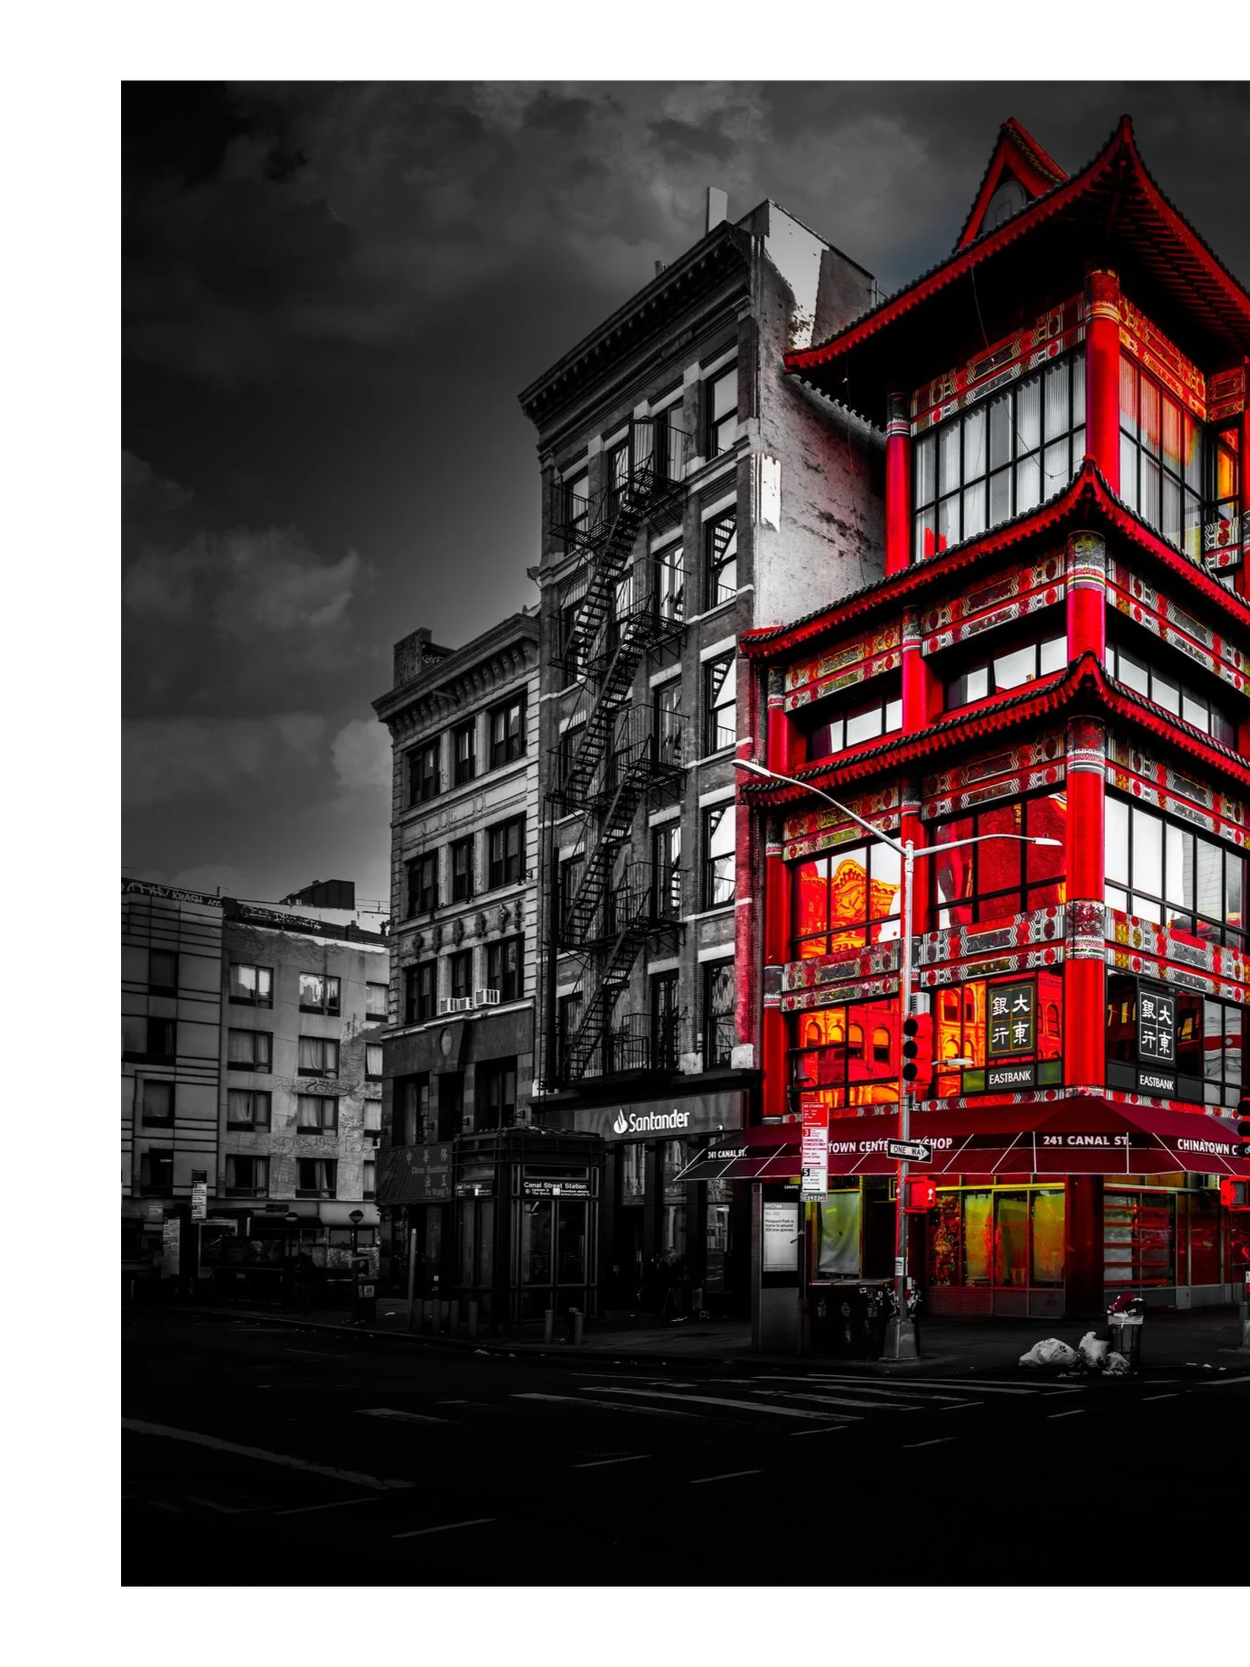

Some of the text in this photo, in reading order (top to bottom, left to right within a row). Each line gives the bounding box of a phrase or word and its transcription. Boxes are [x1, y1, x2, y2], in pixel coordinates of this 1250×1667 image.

[989, 1069, 1031, 1085] EASTBANK
[1139, 1074, 1174, 1091] EASTBANK
[628, 1108, 690, 1132] Santander
[859, 1140, 888, 1153] CENTE
[1043, 1135, 1132, 1146] 241 CANAL ST.
[1177, 1138, 1231, 1156] CHINATOWN
[707, 1151, 717, 1159] 241
[718, 1150, 736, 1158] CANAL
[893, 1145, 926, 1157] ONE WAY
